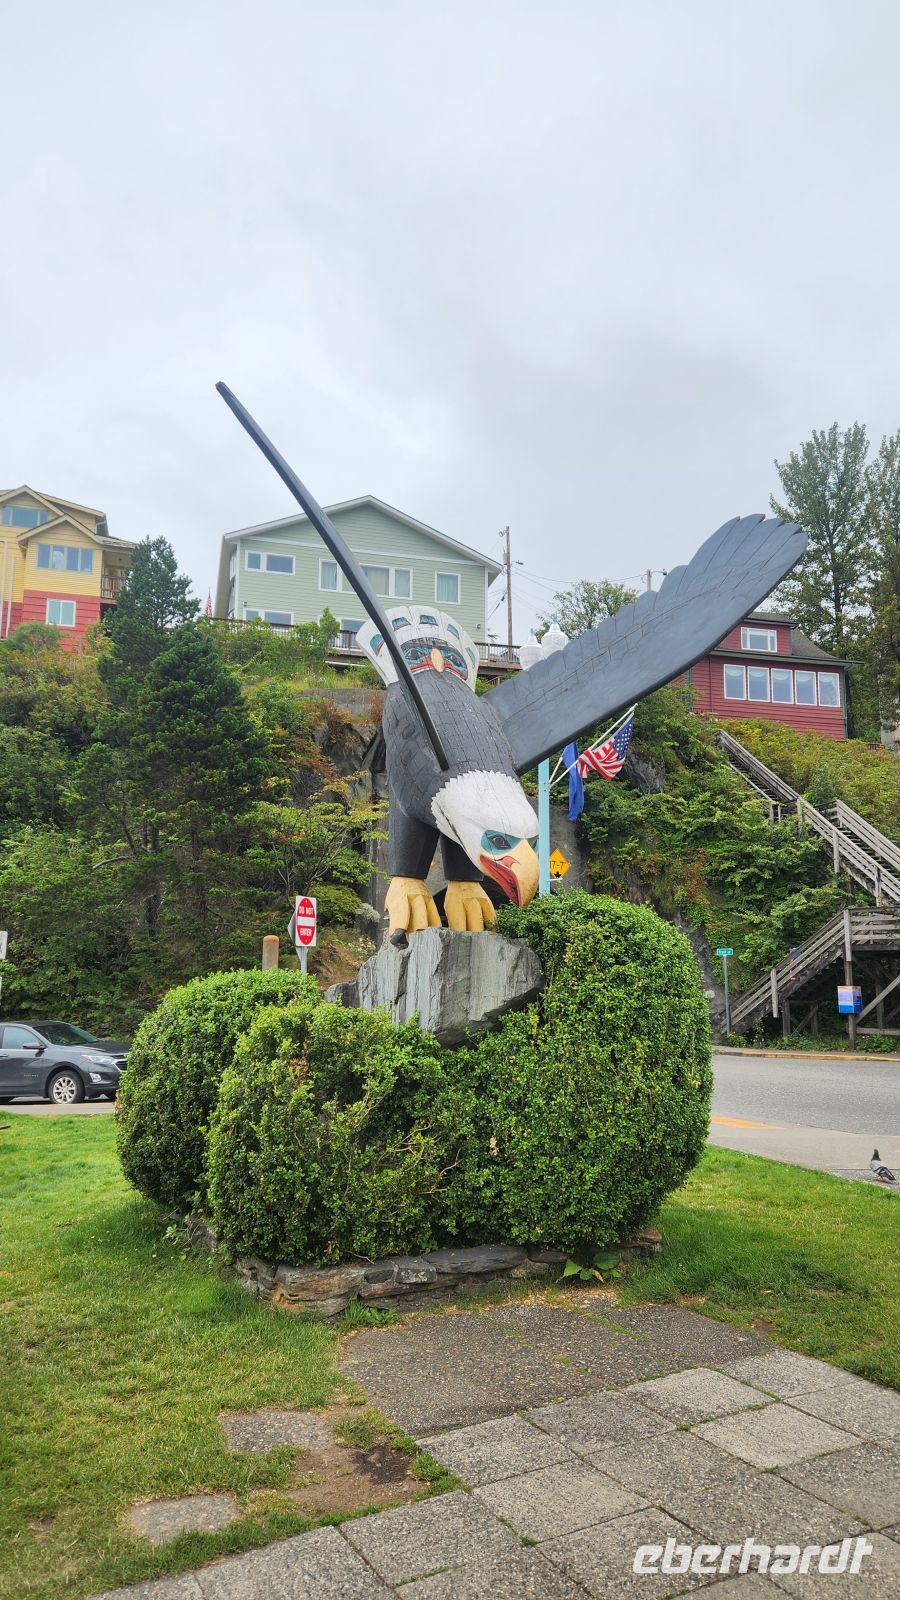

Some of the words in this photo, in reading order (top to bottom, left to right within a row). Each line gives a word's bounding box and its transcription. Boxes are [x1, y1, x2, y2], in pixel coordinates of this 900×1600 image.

[298, 906, 305, 915] DO
[305, 907, 314, 916] NOT
[300, 927, 312, 937] ENTER
